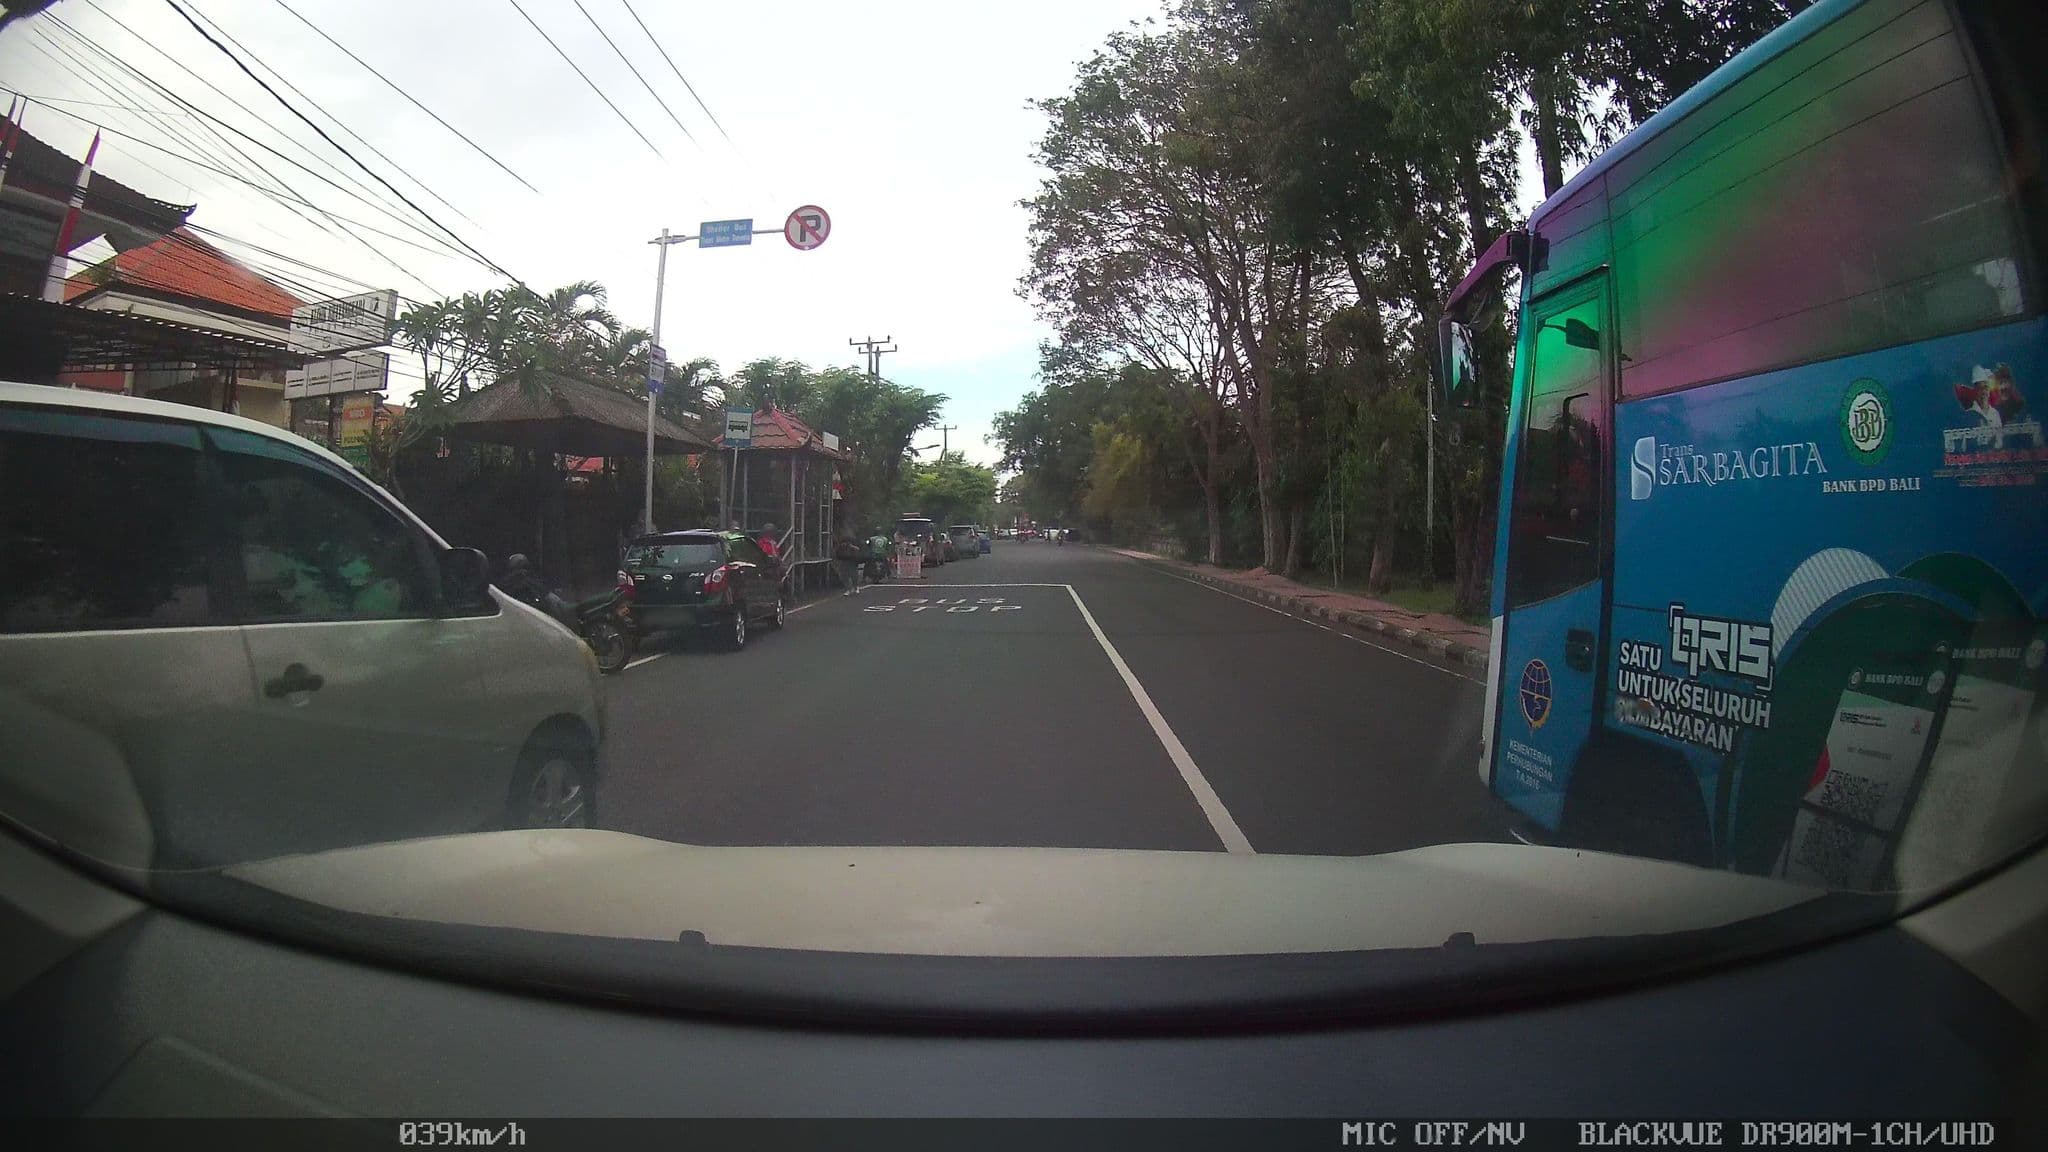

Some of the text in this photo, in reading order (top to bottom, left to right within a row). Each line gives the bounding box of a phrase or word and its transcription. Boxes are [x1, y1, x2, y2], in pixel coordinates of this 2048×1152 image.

[1660, 444, 1694, 458] Trans
[1660, 442, 1828, 487] SARBAGITA
[1822, 477, 1921, 493] BANK BPD BALI
[863, 604, 1023, 613] STOP
[1620, 641, 1662, 672] SATU
[1671, 616, 1771, 678] QRIS
[1618, 669, 1772, 729] UNTUK SELURUH
[1617, 699, 1735, 752] BAYARAN
